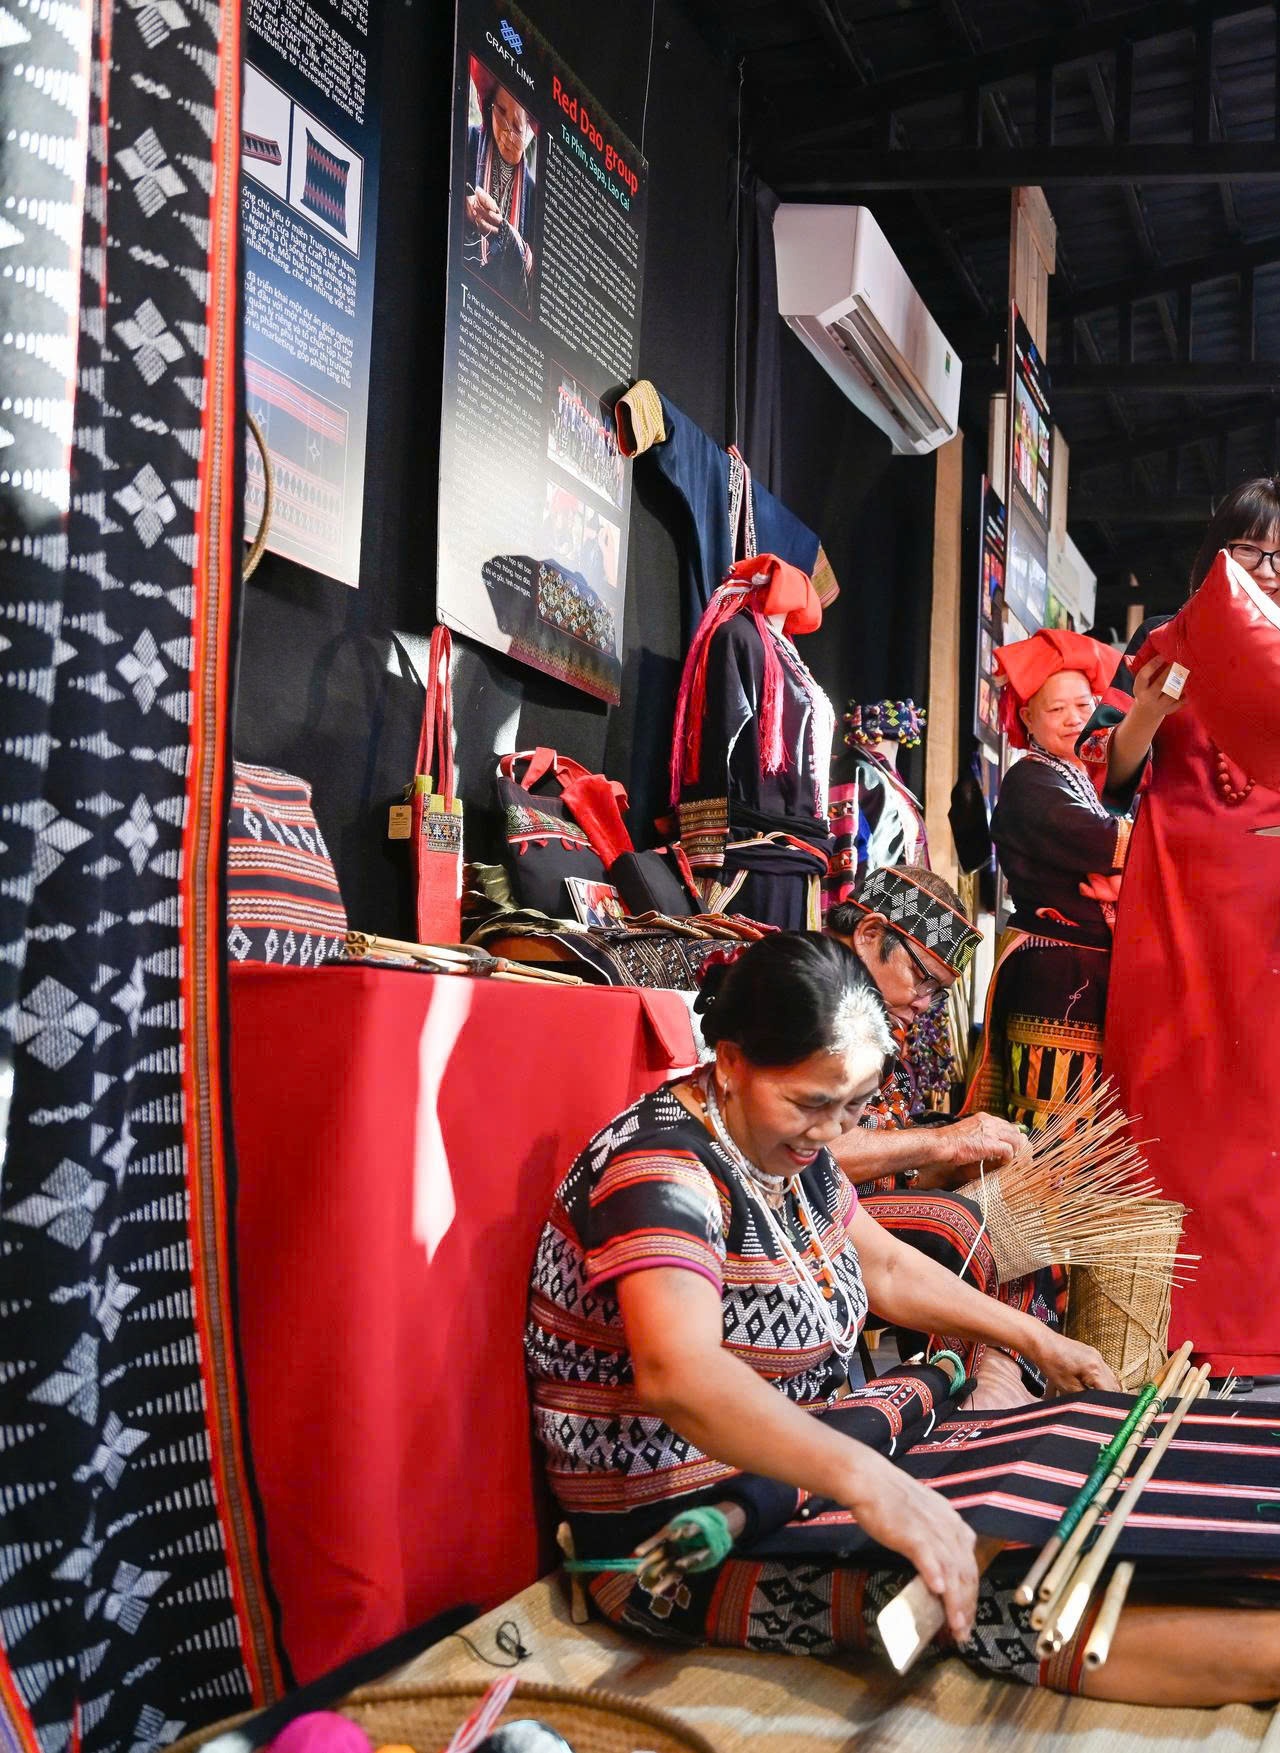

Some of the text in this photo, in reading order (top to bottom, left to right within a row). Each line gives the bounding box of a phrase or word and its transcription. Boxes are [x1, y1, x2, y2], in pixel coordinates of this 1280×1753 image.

[253, 8, 262, 26] by
[263, 18, 284, 44] CRAFT
[285, 38, 300, 58] LINK
[302, 53, 308, 65] to
[309, 60, 333, 90] develop
[334, 84, 347, 100] new
[284, 3, 297, 22] The
[299, 19, 322, 46] women
[325, 42, 349, 71] selected
[351, 66, 365, 85] their
[304, 11, 318, 31] NAV
[318, 24, 336, 49] (since
[354, 59, 365, 75] and
[306, 2, 330, 33] income,
[331, 28, 351, 52] groups
[352, 46, 358, 58] of
[359, 53, 366, 66] Ta
[340, 5, 368, 36] jars, and
[265, 8, 278, 28] and
[280, 22, 301, 47] CRAFT
[354, 89, 364, 105] this
[289, 53, 296, 66] to
[298, 61, 329, 98] increasing
[331, 90, 353, 116] income
[355, 111, 363, 125] for
[321, 49, 350, 84] marketing
[354, 79, 365, 95] and
[486, 29, 534, 89] CRAFT LINK
[552, 74, 637, 197] Red Dao group
[561, 123, 629, 211] Ta Phin, Sapa, Lao Cai
[242, 186, 256, 204] ống
